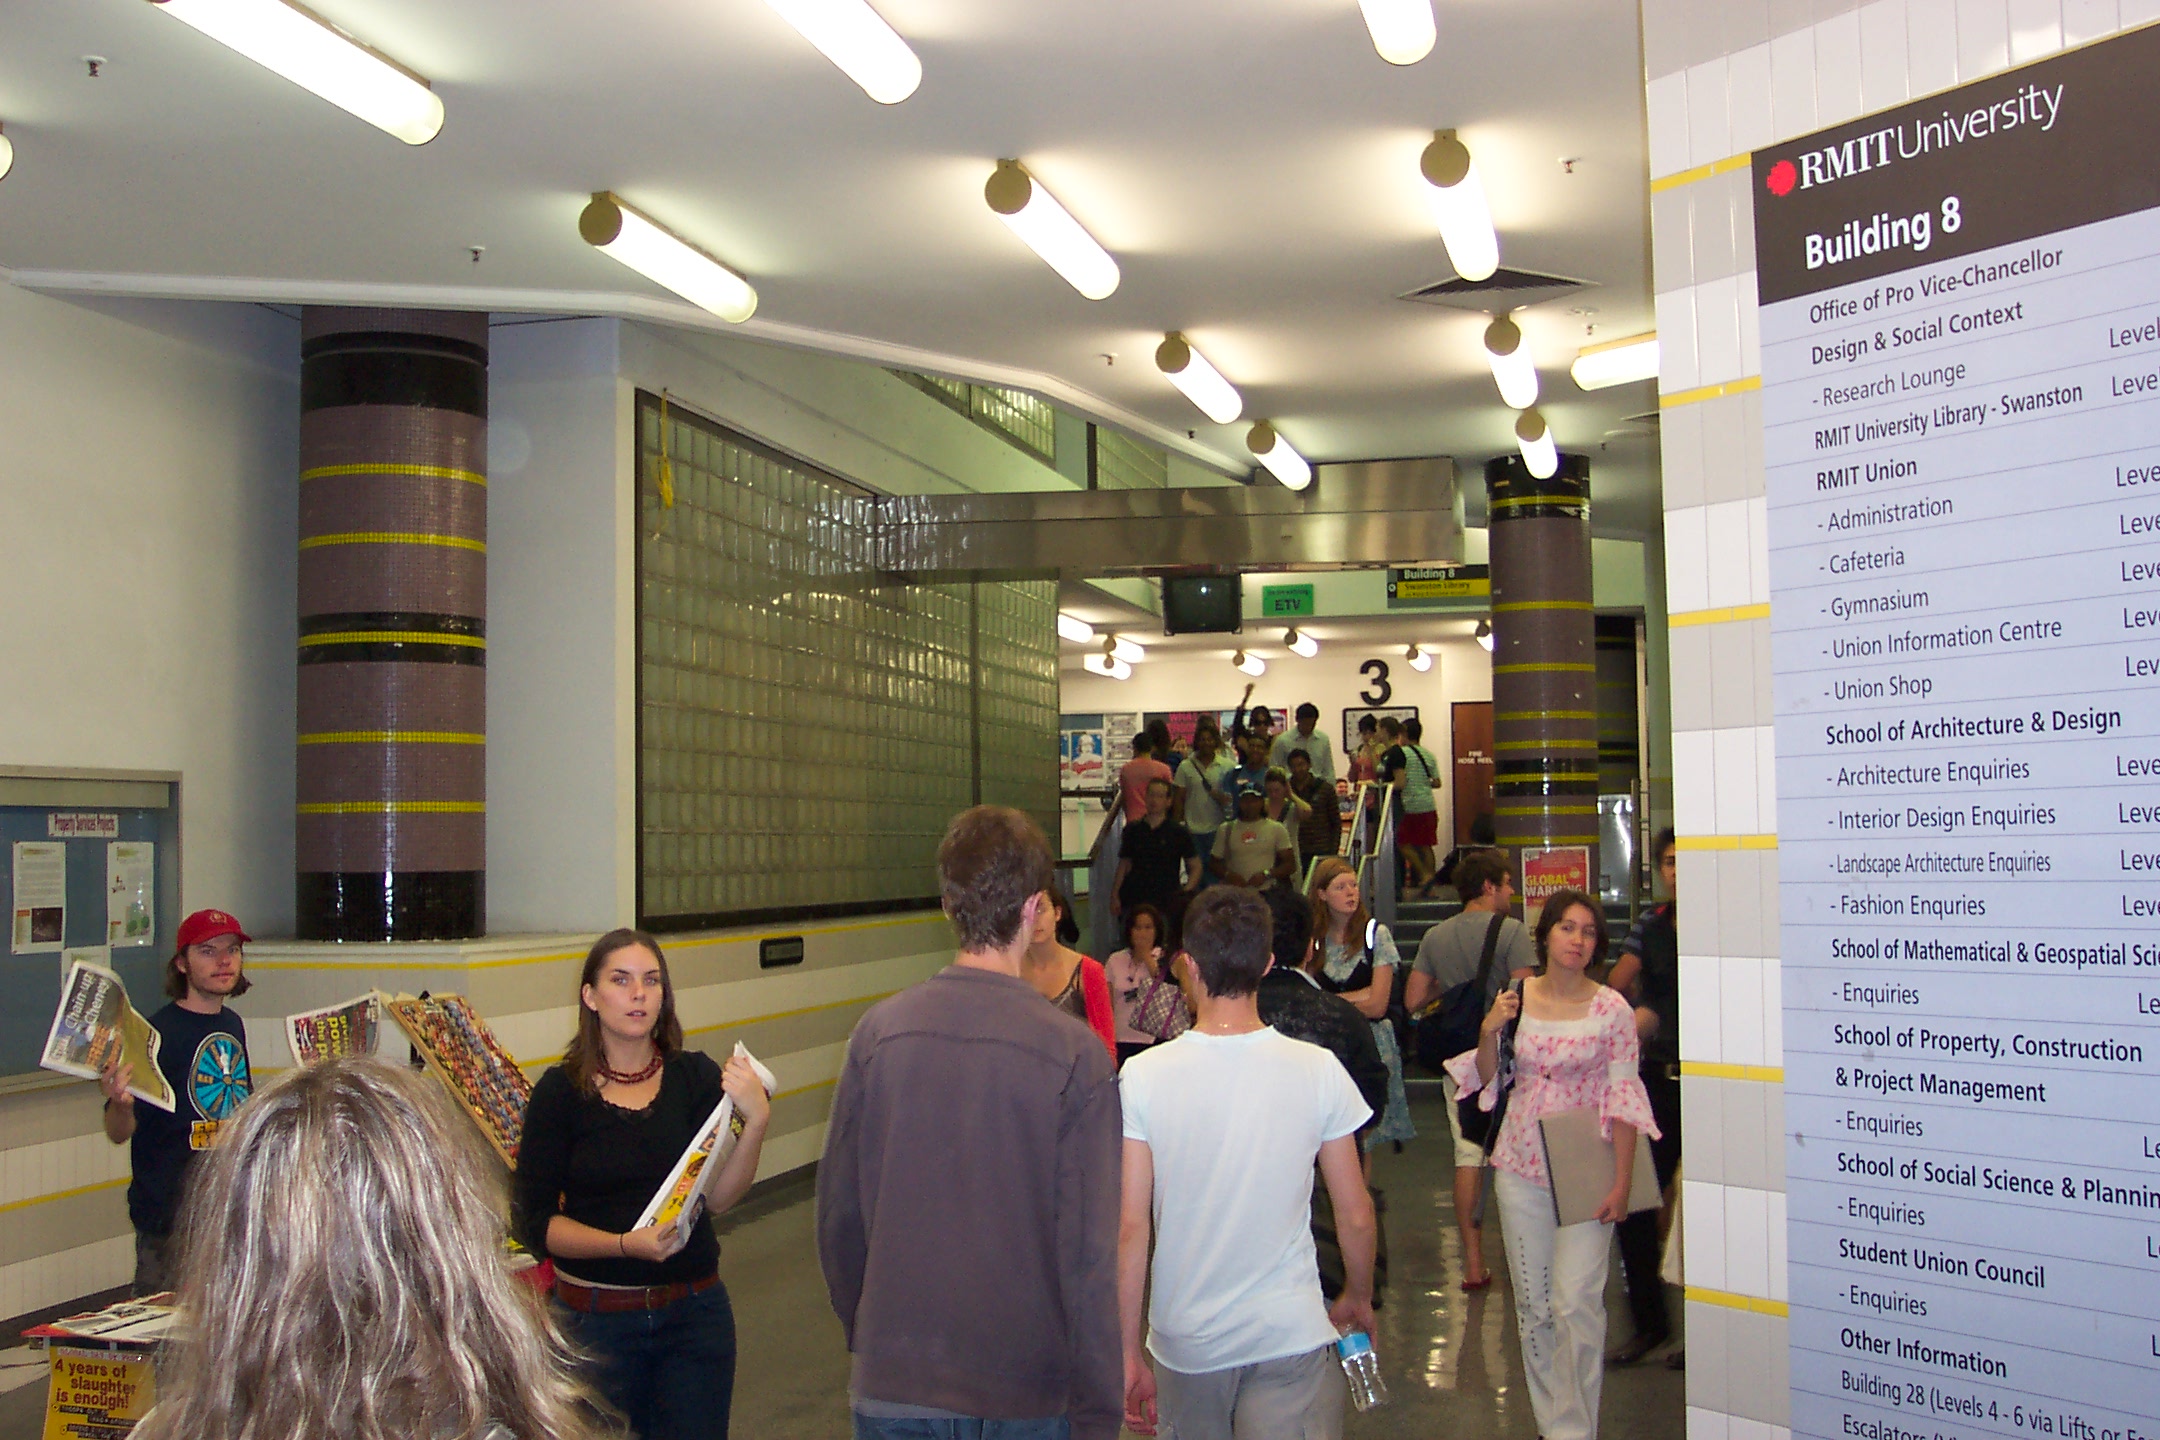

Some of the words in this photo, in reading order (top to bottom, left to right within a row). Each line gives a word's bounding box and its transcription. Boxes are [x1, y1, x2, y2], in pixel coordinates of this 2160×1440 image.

[1804, 209, 1931, 269] Building
[1940, 196, 1962, 234] 8
[1809, 298, 1858, 324] Office
[1862, 288, 1880, 312] of
[1885, 286, 1915, 307] Pro
[1919, 248, 2064, 298] Vice-Chancellor
[1811, 338, 1868, 366] Design
[1874, 331, 1887, 352] &
[1892, 316, 1943, 348] Social
[1948, 301, 2024, 334] Context
[2109, 316, 2160, 348] Level
[1823, 373, 1896, 407] Research
[1901, 363, 1966, 391] Lounge
[2112, 367, 2160, 396] Leve
[1814, 425, 1851, 450] RMIT
[1855, 411, 1929, 443] University
[1933, 403, 1987, 428] Library
[2000, 385, 2083, 416] Swanston
[1816, 465, 1860, 491] RMIT
[1865, 458, 1918, 483] Union
[2115, 465, 2160, 487] Leve
[1827, 496, 1953, 532] Administration
[2120, 514, 2160, 535] Leve
[1403, 568, 1446, 580] Building
[1448, 567, 1455, 578] 8
[1829, 545, 1905, 574] Cafeteria
[1275, 598, 1301, 611] ETV
[1831, 589, 1929, 622] Gymnasium
[1833, 638, 1883, 659] Union
[1888, 624, 1993, 654] Information
[1999, 619, 2062, 642] Centre
[1359, 658, 1392, 707] 3
[1834, 678, 1884, 701] Union
[1889, 674, 1933, 700] Shop
[1826, 720, 1882, 746] School
[1887, 719, 1906, 742] of
[1910, 716, 2024, 741] Architecture
[2030, 711, 2046, 733] &
[2052, 706, 2122, 735] Design
[1836, 764, 1942, 787] Architecture
[1947, 757, 2030, 787] Enquiries
[2116, 755, 2160, 776] Leve
[1838, 810, 1902, 830] Interior
[1906, 805, 1966, 833] Design
[1971, 802, 2056, 832] Enquiries
[2118, 802, 2160, 823] Leve
[1525, 873, 1569, 887] GLOBAL
[1836, 852, 1902, 879] Landscape
[1904, 851, 1985, 873] Architecture
[1988, 851, 2051, 878] Enquiries
[1841, 893, 1904, 915] Fashion
[1910, 894, 1986, 921] Enquries
[1831, 937, 1880, 959] School
[1883, 938, 1900, 960] of
[1904, 938, 2011, 963] Mathematical
[2016, 941, 2030, 963] &
[2034, 942, 2127, 971] Geospatial
[1843, 981, 1920, 1009] Enquiries
[1834, 1023, 1891, 1047] School
[1896, 1026, 1915, 1049] of
[1920, 1028, 2006, 1060] Property,
[2012, 1033, 2143, 1063] Construction
[1835, 1066, 1849, 1087] &
[1853, 1067, 1914, 1096] Project
[1919, 1072, 2047, 1104] Management
[1846, 1110, 1924, 1138] Enquiries
[1837, 1151, 1894, 1178] School
[1899, 1158, 1918, 1181] of
[1923, 1161, 1977, 1188] Social
[1982, 1167, 2054, 1197] Science
[2061, 1176, 2077, 1199] &
[2083, 1178, 2160, 1210] Plannin
[1848, 1196, 1926, 1226] Enquiries
[1839, 1237, 1908, 1268] Student
[1913, 1248, 1969, 1277] Union
[1974, 1258, 2045, 1289] Council
[1850, 1284, 1928, 1317] Enquiries
[55, 1358, 64, 1372] 4
[68, 1362, 108, 1377] years
[112, 1364, 127, 1379] of
[1840, 1327, 1892, 1356] Other
[1896, 1337, 2007, 1379] Information
[56, 1387, 69, 1403] is
[73, 1392, 129, 1411] enough!
[70, 1376, 137, 1396] slaughter
[1841, 1369, 1902, 1407] Building
[1906, 1382, 1925, 1406] 28
[1987, 1400, 1999, 1422] 4
[2013, 1405, 2024, 1427] 6
[2028, 1408, 2053, 1434] via
[2059, 1414, 2096, 1440] Lifts
